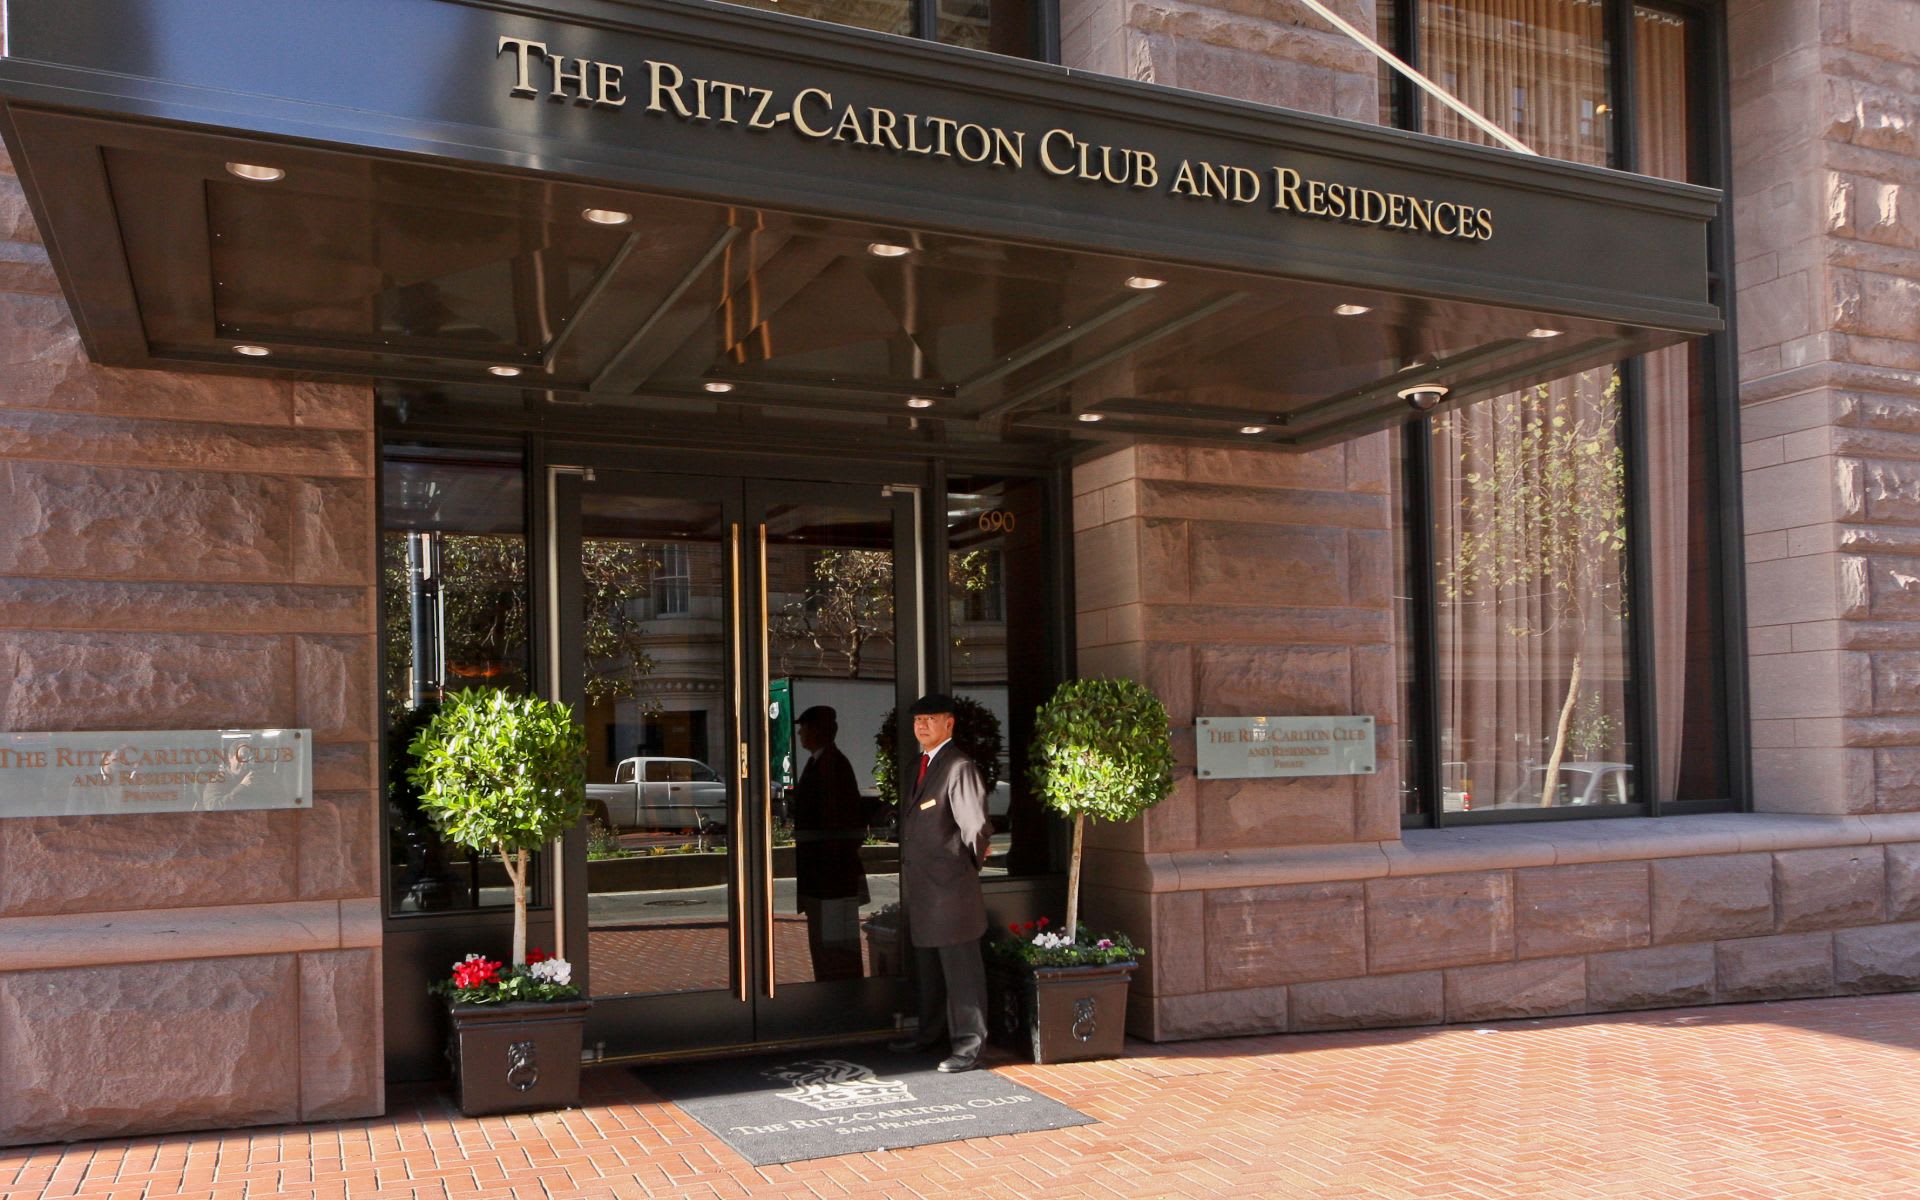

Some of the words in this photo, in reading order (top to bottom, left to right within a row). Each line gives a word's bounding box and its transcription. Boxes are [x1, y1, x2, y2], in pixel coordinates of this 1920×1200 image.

[498, 36, 626, 106] THE
[644, 60, 1025, 169] RITZ-CARLTON
[1040, 129, 1158, 188] CLUB
[1171, 159, 1260, 202] AND
[1273, 166, 1492, 241] RESIDENCES
[979, 511, 1014, 532] 690
[1207, 728, 1235, 743] THE
[1239, 727, 1331, 742] RI-CARLTON
[1333, 727, 1366, 741] CLUB
[0, 748, 48, 769] THE
[236, 744, 294, 763] CLUB
[72, 773, 113, 787] AND
[118, 770, 226, 785] RESIDENCES
[729, 1123, 789, 1136] THE
[967, 1094, 1032, 1109] CLUB
[835, 1124, 877, 1135] SAN
[878, 1113, 977, 1130] FRANCISCO
